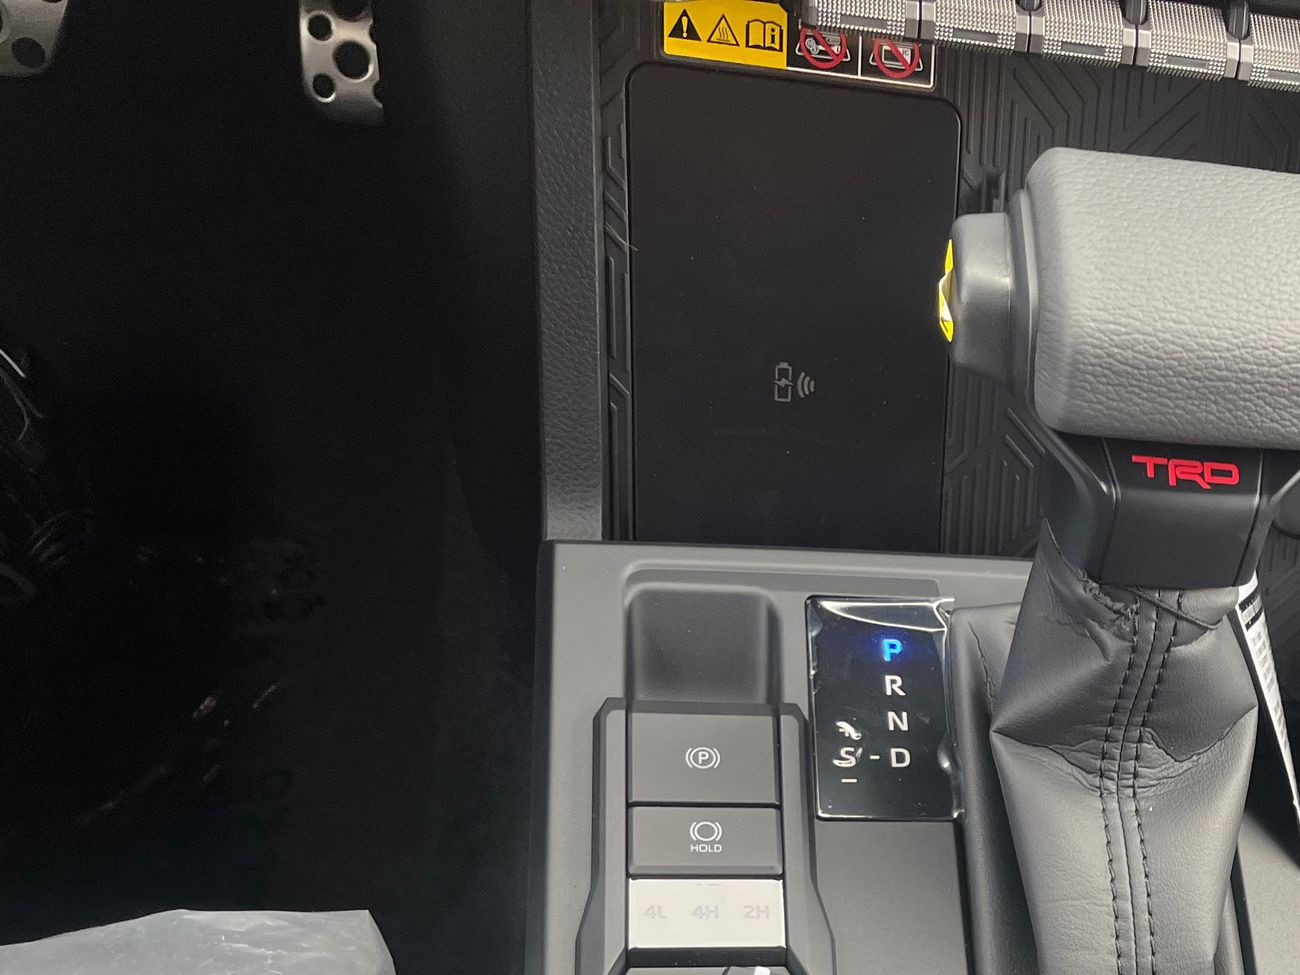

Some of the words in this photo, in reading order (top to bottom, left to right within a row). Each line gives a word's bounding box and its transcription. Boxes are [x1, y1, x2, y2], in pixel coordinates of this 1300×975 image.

[1131, 454, 1240, 489] TRD
[881, 638, 903, 662] P
[884, 675, 906, 696] R
[887, 711, 909, 731] N
[890, 747, 911, 768] D
[690, 843, 722, 853] HOLD
[643, 904, 667, 919] 4L
[691, 904, 719, 919] 4H
[743, 904, 770, 919] 2H
